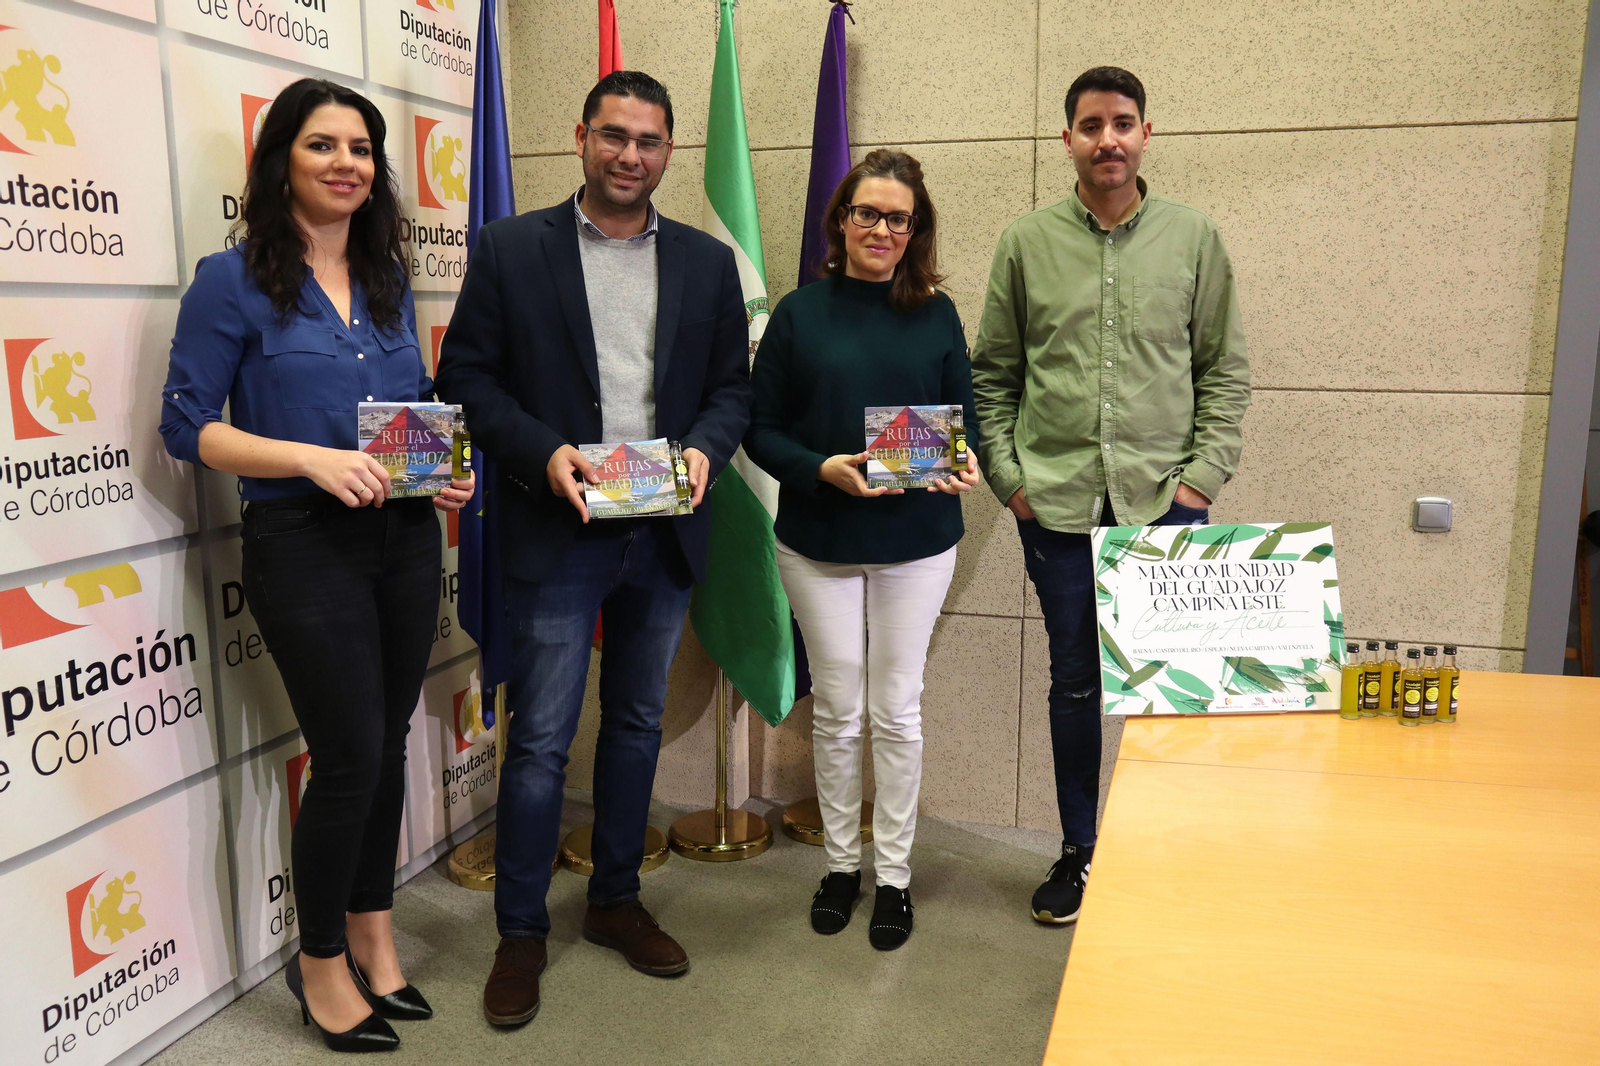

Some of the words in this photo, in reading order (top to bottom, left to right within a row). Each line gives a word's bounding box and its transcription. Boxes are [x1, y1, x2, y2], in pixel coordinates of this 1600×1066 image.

[238, 0, 329, 50] Córdoba
[400, 9, 471, 52] Diputación
[401, 38, 417, 60] de
[422, 44, 473, 76] Córdoba
[381, 429, 432, 445] RUTAS
[886, 427, 931, 441] RUTAS
[0, 443, 130, 489] iputación
[604, 459, 652, 473] RUTAS
[875, 446, 944, 460] GUADAJOZ
[30, 479, 134, 516] Córdoba
[594, 473, 667, 491] GUADAJOZ
[1138, 562, 1294, 580] MANCOMUNIDAD
[1150, 581, 1184, 596] DEL
[1187, 579, 1287, 595] GUADAJOZ
[1153, 593, 1239, 612] CAMPIÑA
[1242, 594, 1286, 610] ESTE
[1200, 621, 1219, 647] y
[1219, 604, 1296, 640] Aceite
[225, 630, 262, 667] de
[1, 629, 197, 738] putación
[31, 686, 203, 776] Córdoba
[443, 790, 458, 810] de
[270, 907, 295, 935] de
[42, 938, 176, 1034] Diputación
[44, 1033, 77, 1064] de
[86, 967, 180, 1036] Córdoba
